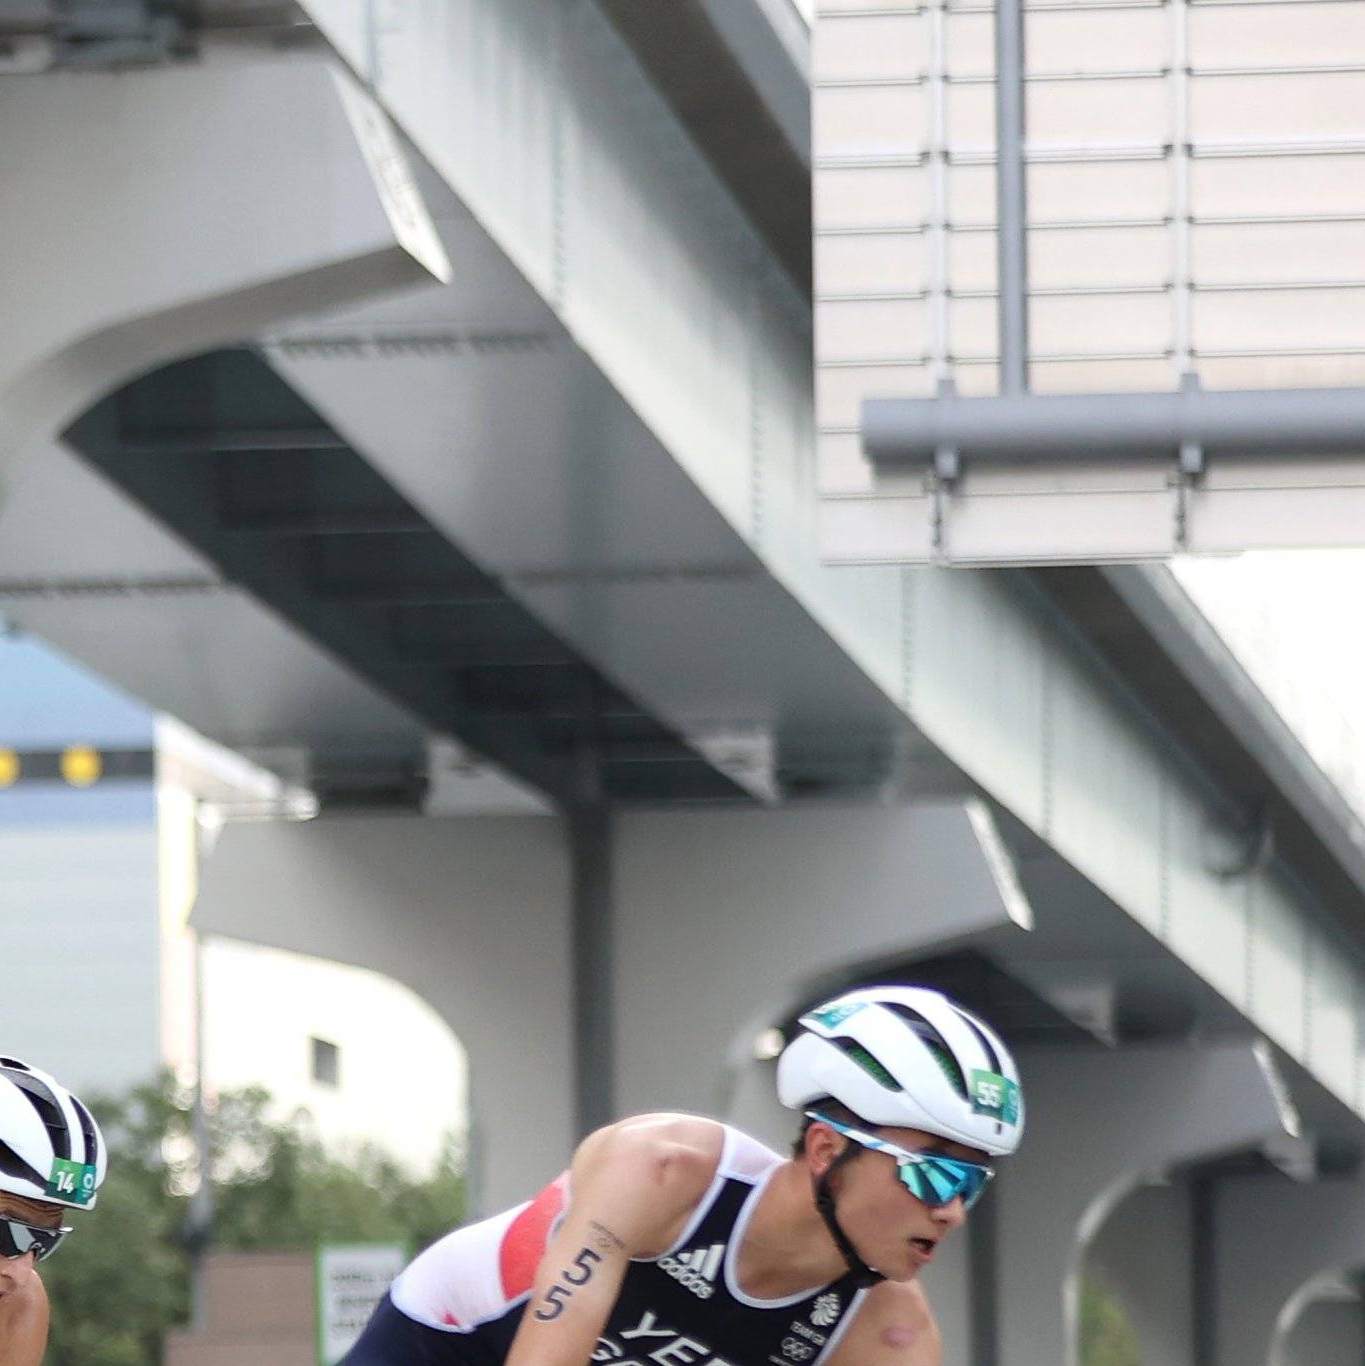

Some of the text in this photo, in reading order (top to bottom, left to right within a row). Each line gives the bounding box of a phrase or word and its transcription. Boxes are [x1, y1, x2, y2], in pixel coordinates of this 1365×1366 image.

[976, 1079, 1003, 1110] 55
[55, 1170, 77, 1195] 14
[656, 1255, 717, 1301] adidas
